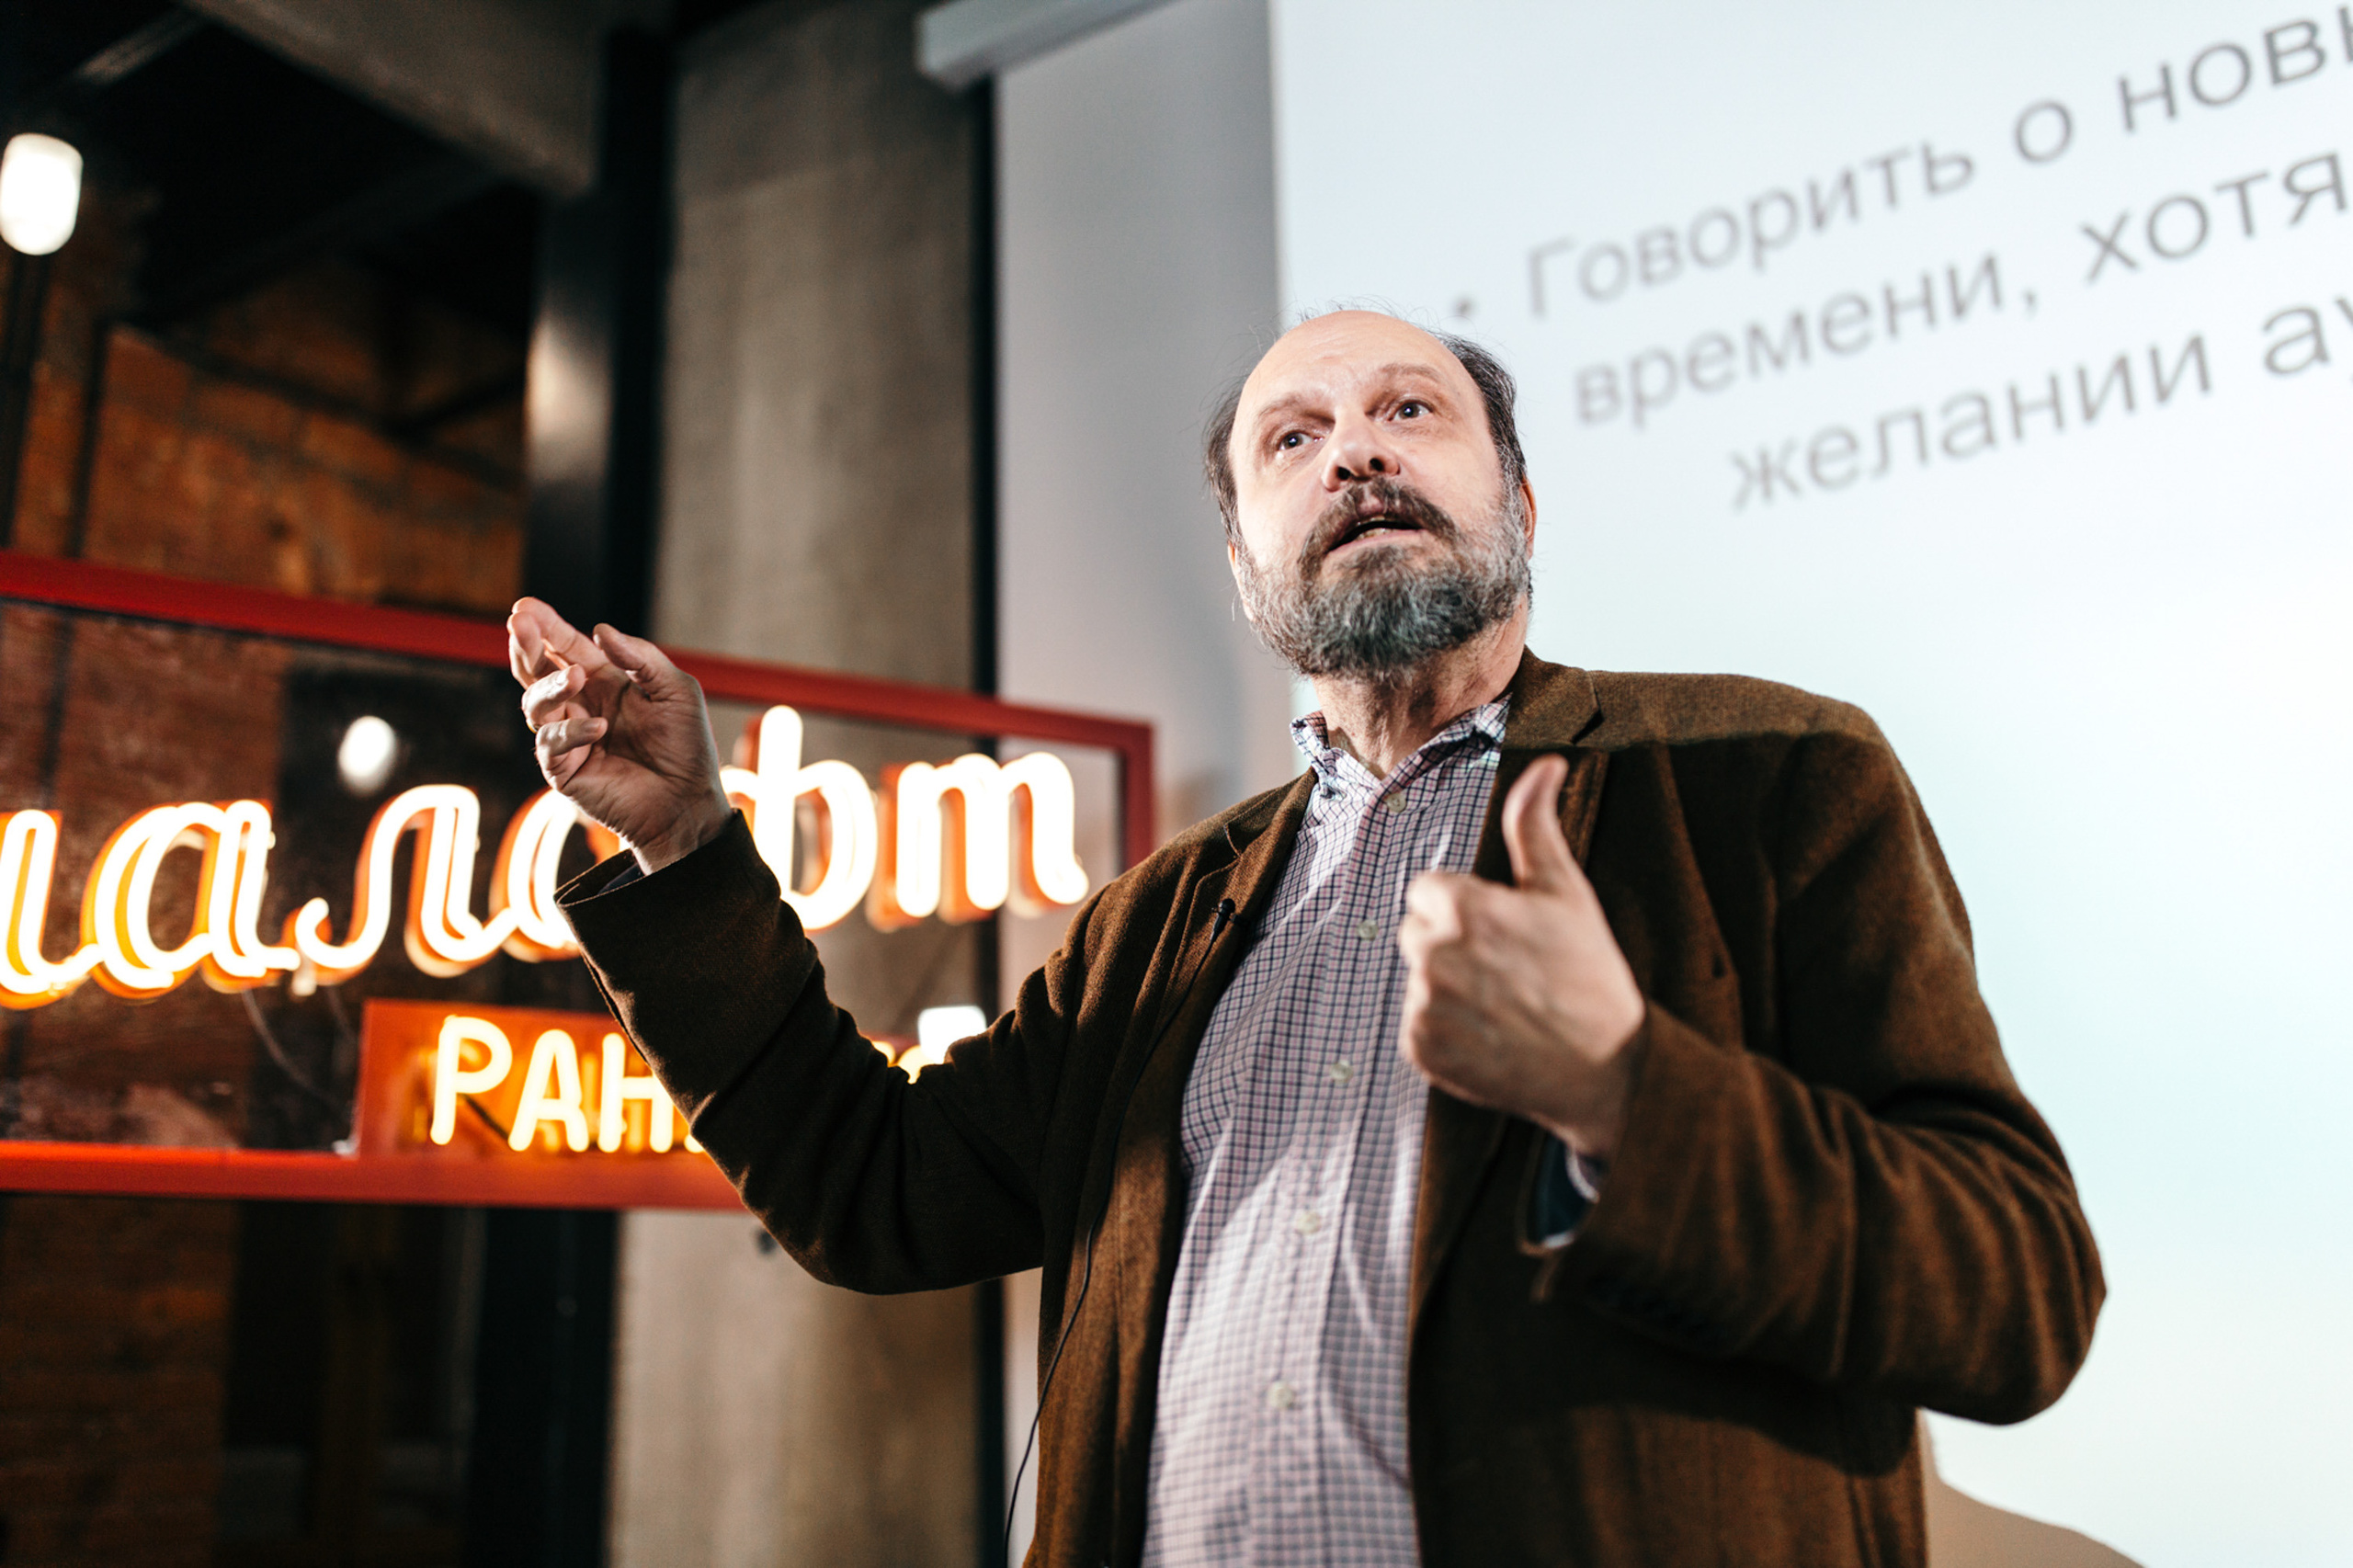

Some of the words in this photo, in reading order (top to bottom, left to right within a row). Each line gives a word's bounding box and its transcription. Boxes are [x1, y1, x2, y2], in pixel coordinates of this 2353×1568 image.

[1525, 140, 1976, 319] Говорить
[2012, 99, 2075, 165] о
[2116, 4, 2353, 135] нов
[2079, 150, 2349, 286] хотя
[1730, 333, 2213, 513] желании
